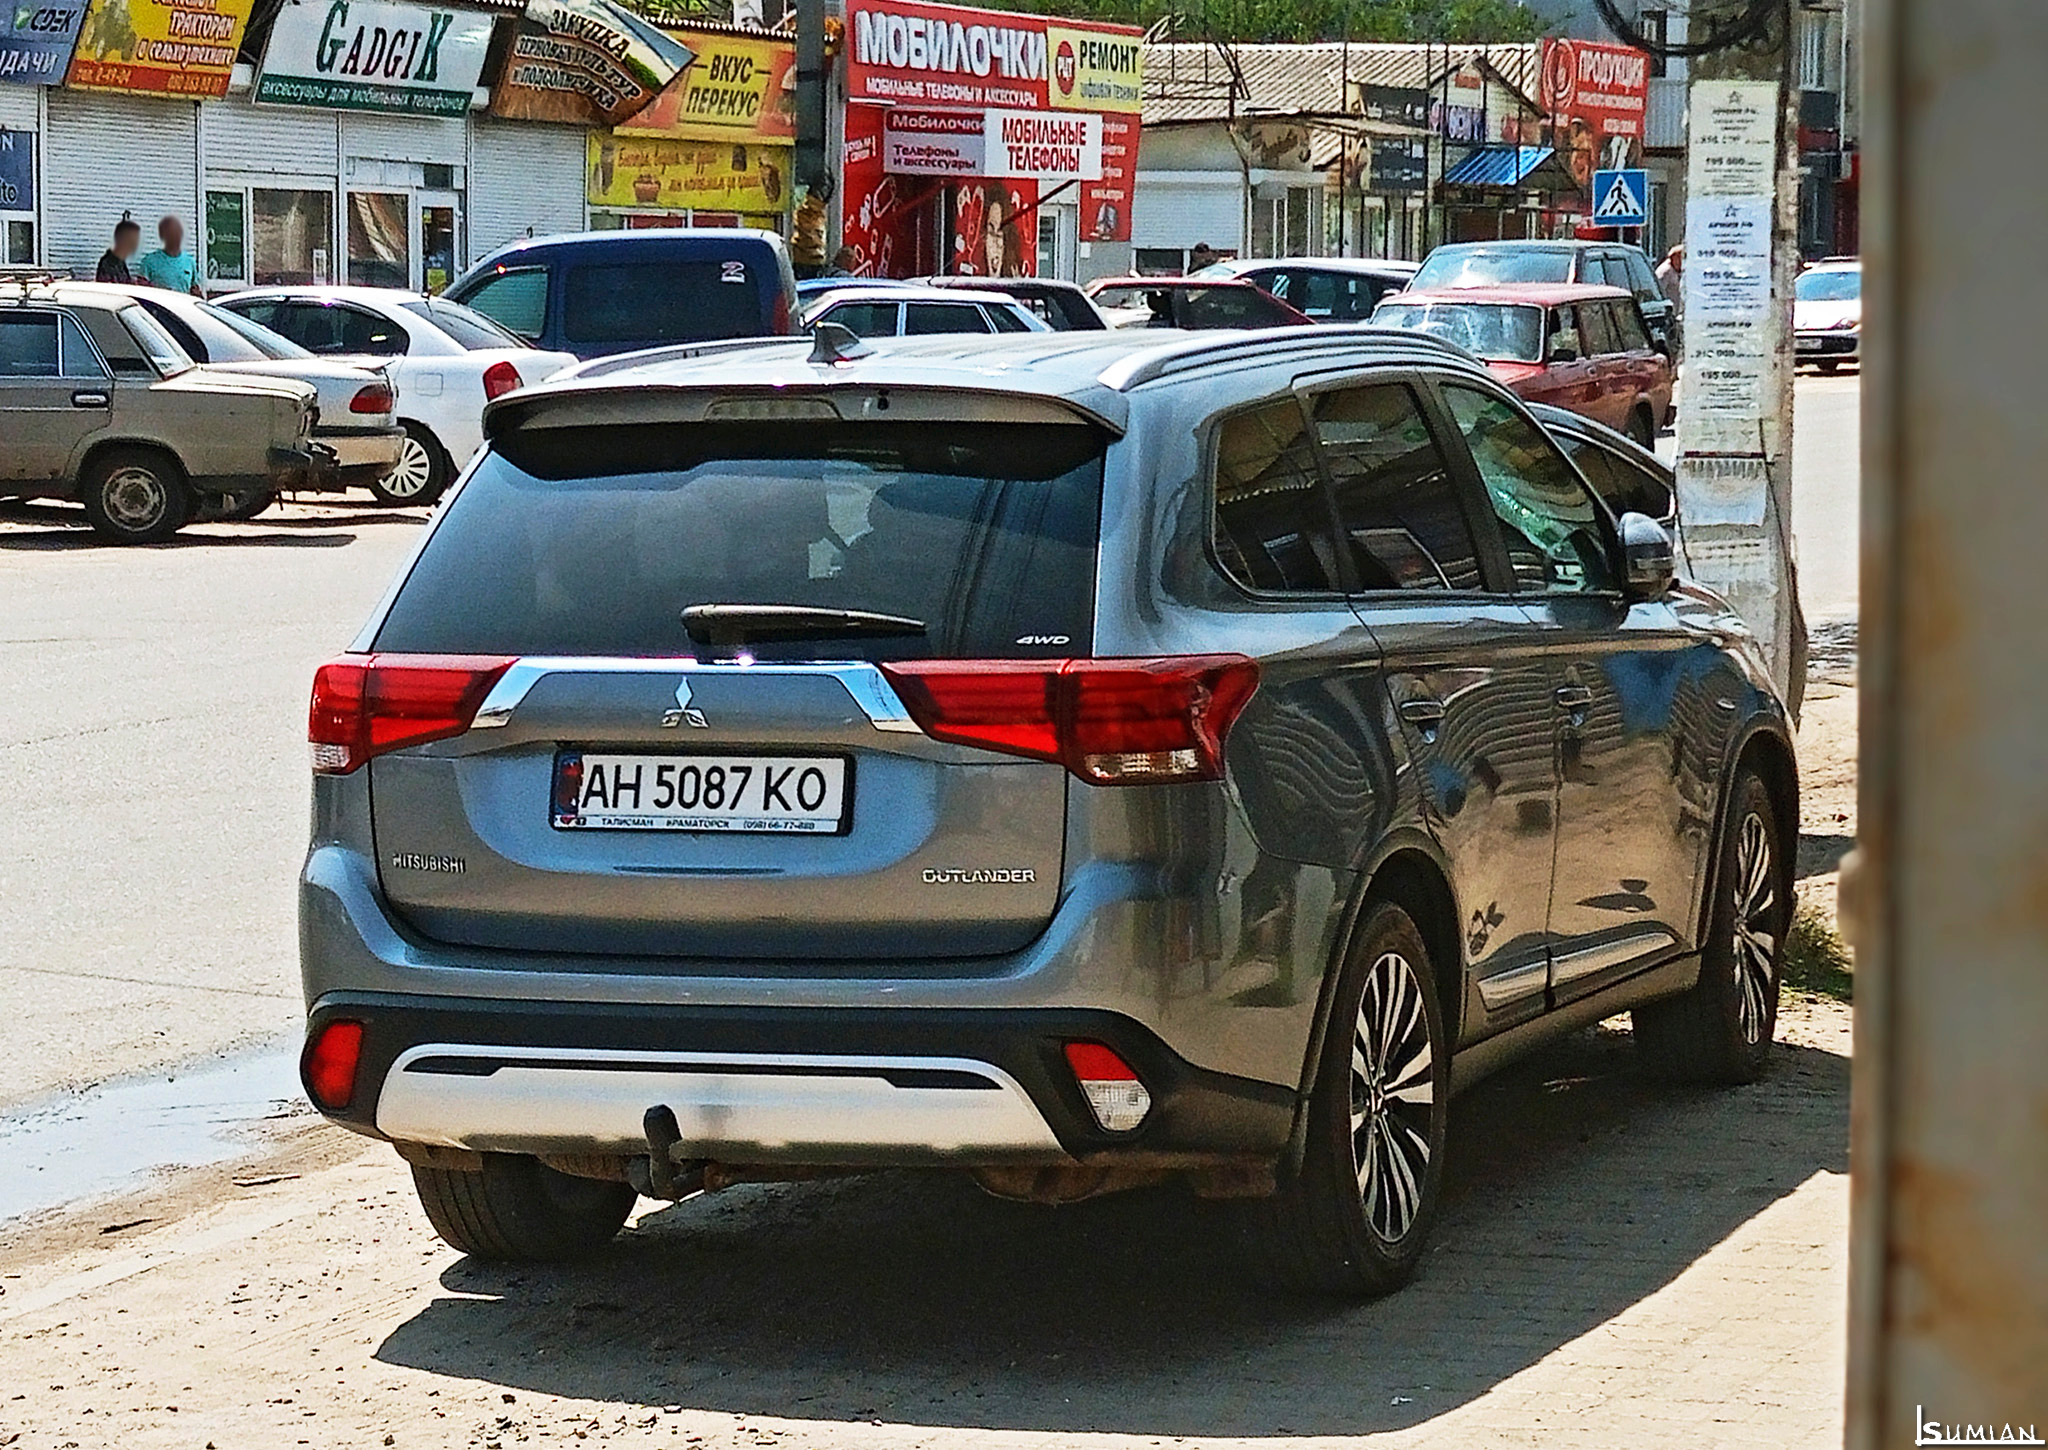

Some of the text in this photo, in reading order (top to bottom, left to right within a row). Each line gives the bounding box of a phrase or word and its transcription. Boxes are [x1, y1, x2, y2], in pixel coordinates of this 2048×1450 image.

[169, 10, 237, 41] ТРАКТОРАМ
[550, 9, 630, 59] ЗАКУПКА
[855, 10, 1048, 81] МОБИЛОЧКИ
[1080, 40, 1138, 73] РЕМОНТ
[710, 54, 753, 82] ВКУС
[262, 81, 466, 113] аксессуары для мобильных телефонов
[686, 87, 759, 117] ПЕРЕКУС
[866, 77, 924, 97] МОБИЛЬНЫЕ
[925, 83, 974, 102] ТЕЛЕФОНЫ
[984, 88, 1038, 106] АКСЕССУАРЫ
[1002, 118, 1086, 145] МОБИЛЬНЫЕ
[893, 145, 960, 158] Телефоны
[893, 158, 976, 170] и аксессуары
[1007, 145, 1079, 172] ТЕЛЕФОНЫ
[1016, 635, 1070, 645] 4WD
[581, 764, 826, 812] AH 5087 KO
[602, 818, 653, 827] ТАЛИСМАН
[392, 853, 465, 874] MITSUBISHI
[922, 869, 1036, 883] OUTLANDER
